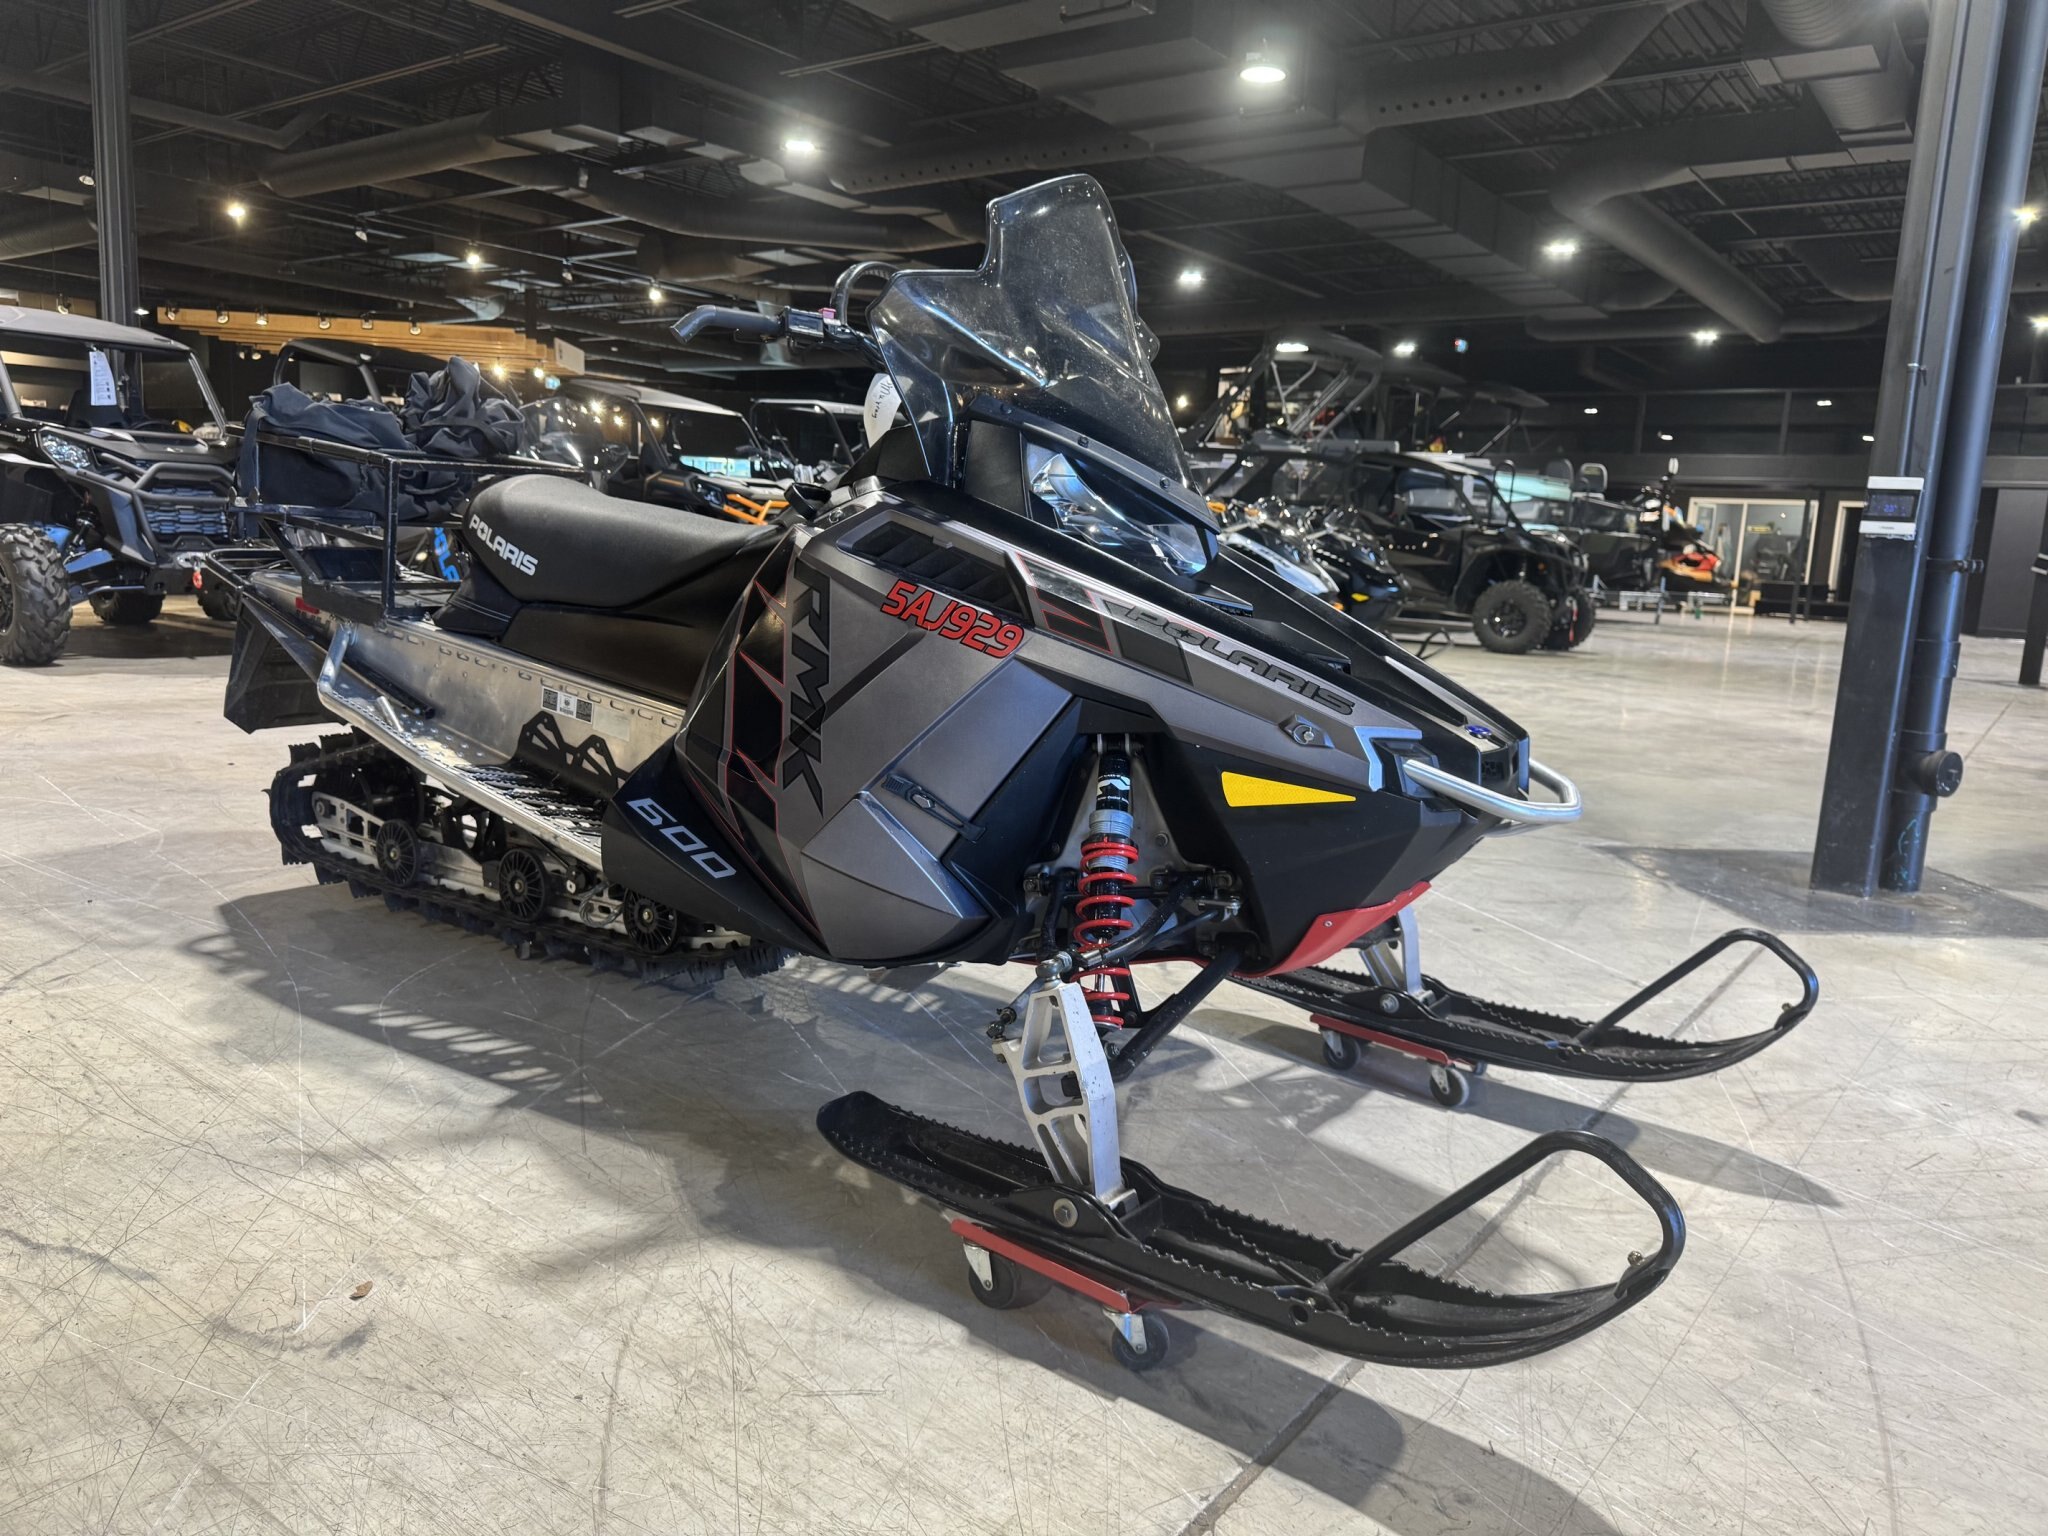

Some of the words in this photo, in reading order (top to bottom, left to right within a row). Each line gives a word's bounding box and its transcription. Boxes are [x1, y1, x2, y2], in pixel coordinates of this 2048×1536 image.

[469, 514, 539, 576] POLARIS
[880, 579, 1024, 659] 5AJ929
[1104, 600, 1356, 716] POLARIS
[782, 557, 831, 820] RMK
[626, 798, 737, 879] 600
